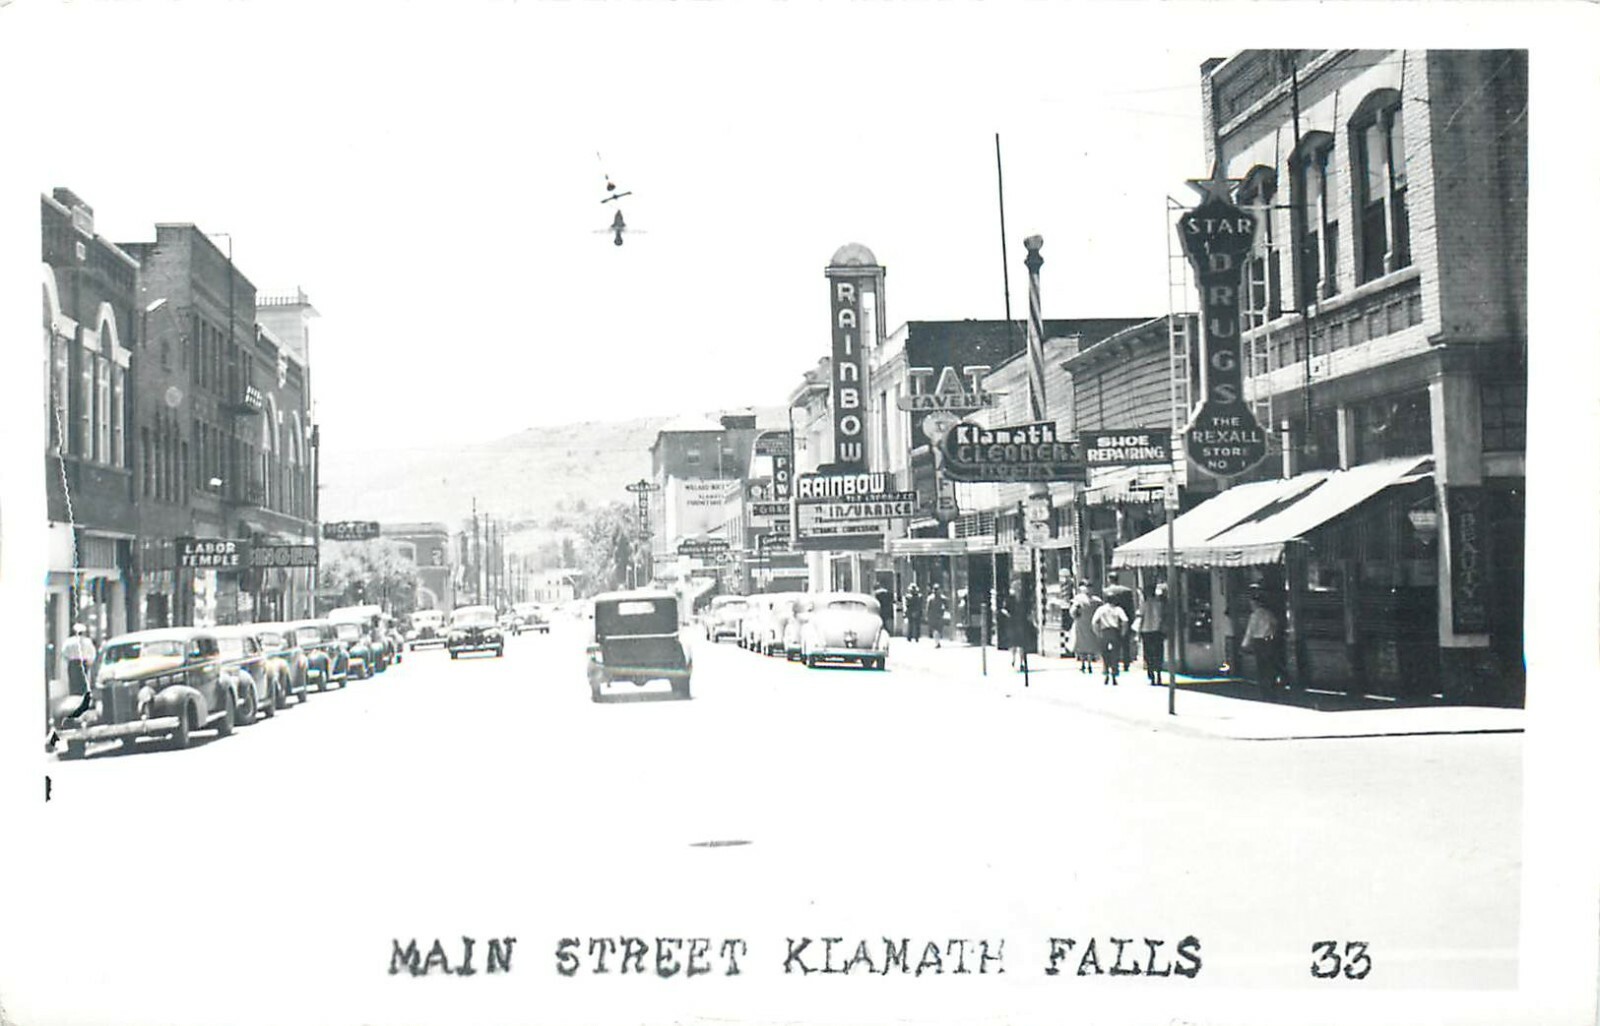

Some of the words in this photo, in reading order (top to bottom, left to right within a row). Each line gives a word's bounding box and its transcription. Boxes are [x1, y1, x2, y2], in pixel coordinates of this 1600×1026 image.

[1187, 217, 1252, 235] STAR
[1209, 253, 1237, 405] DRUGS
[837, 282, 862, 462] RAINBOW
[908, 365, 992, 396] TAT
[910, 393, 993, 409] TAVERN
[1213, 417, 1241, 427] THE
[957, 421, 1055, 446] Klamath
[1096, 435, 1150, 447] SHOE
[1193, 430, 1262, 443] REXALL
[958, 443, 1081, 463] CLEANERS
[1087, 445, 1165, 462] REPAIRING
[1208, 460, 1228, 470] NO
[800, 473, 886, 498] RAINBOW
[829, 502, 911, 517] INSURANCE
[326, 522, 375, 534] HOTEL
[185, 542, 236, 555] LABOR
[182, 554, 240, 567] TEMPLE
